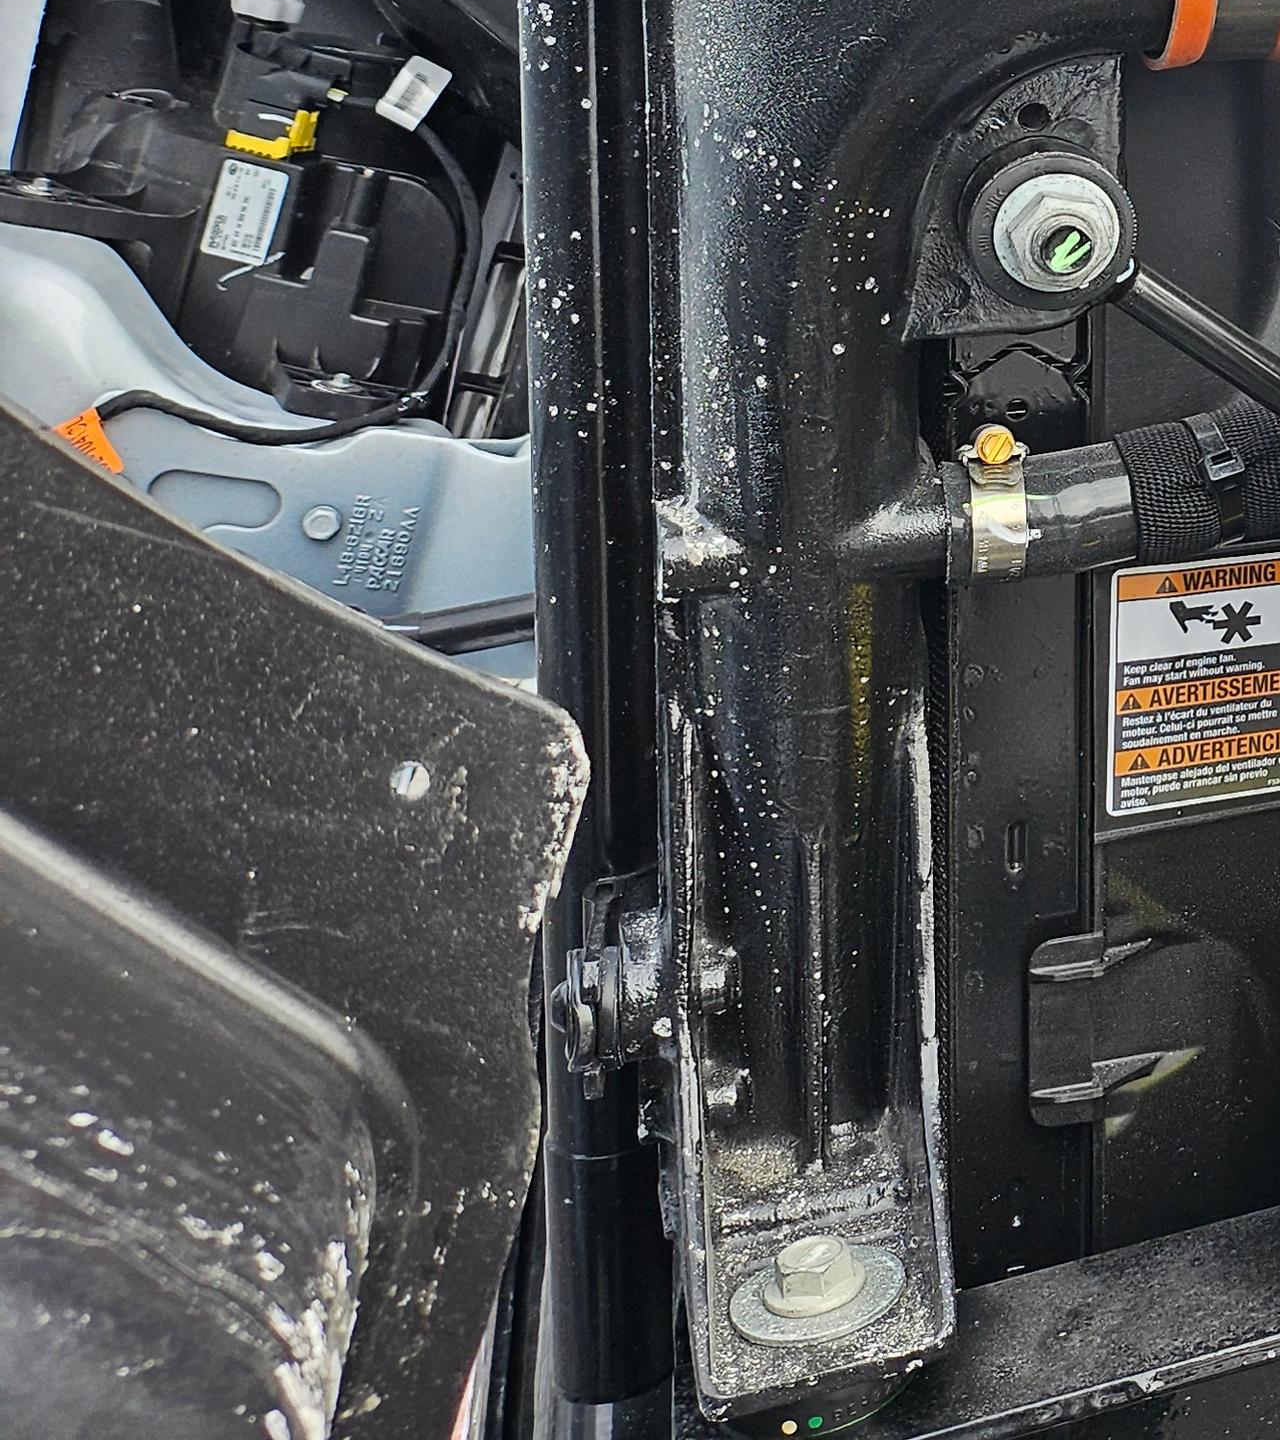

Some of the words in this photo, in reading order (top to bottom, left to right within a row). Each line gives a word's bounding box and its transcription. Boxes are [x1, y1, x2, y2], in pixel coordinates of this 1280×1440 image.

[1183, 563, 1276, 591] WARNING
[1123, 676, 1141, 686] Fan
[1143, 674, 1163, 686] may
[1165, 670, 1187, 681] start
[1189, 666, 1224, 679] without
[1226, 661, 1265, 674] warning.
[1124, 664, 1147, 675] Keep
[1149, 662, 1172, 672] clear
[1175, 659, 1184, 669] of
[1186, 656, 1217, 669] engine
[1219, 654, 1236, 663] fan.
[1196, 707, 1207, 717] du
[1210, 701, 1257, 715] ventilateur
[1260, 698, 1272, 708] du
[1197, 717, 1233, 730] pourrait
[1248, 710, 1277, 720] mettre
[1215, 763, 1229, 773] del
[1153, 782, 1180, 796] puede
[1183, 777, 1222, 789] arrancar
[1240, 769, 1268, 782] previo
[1120, 797, 1148, 808] aviso.
